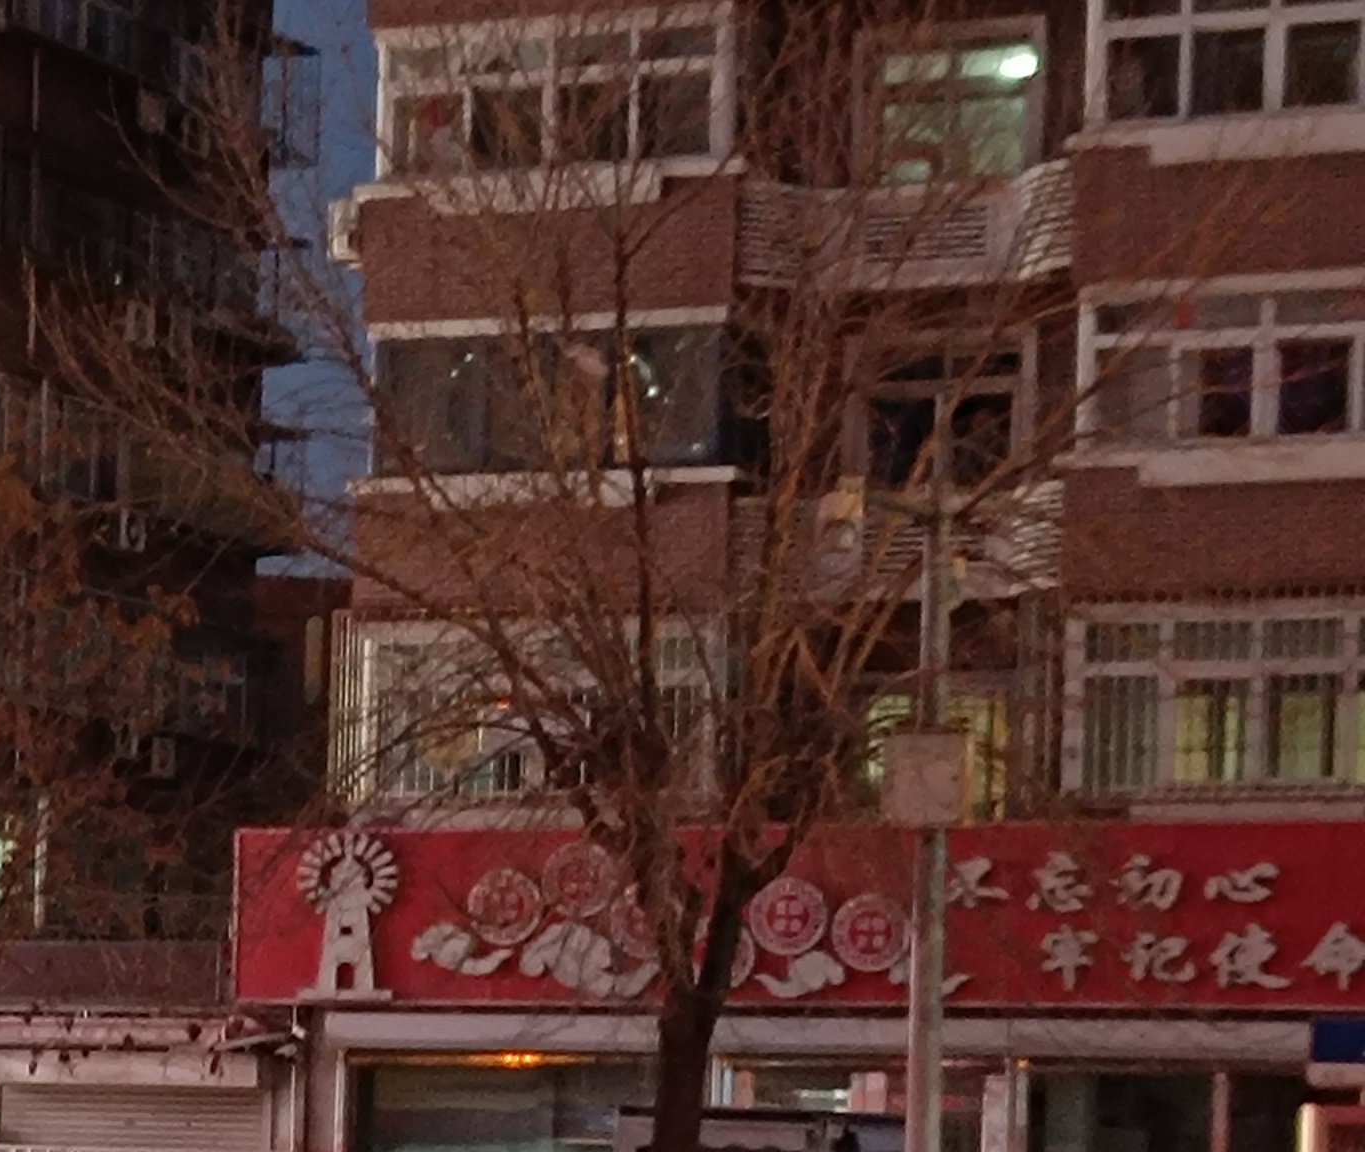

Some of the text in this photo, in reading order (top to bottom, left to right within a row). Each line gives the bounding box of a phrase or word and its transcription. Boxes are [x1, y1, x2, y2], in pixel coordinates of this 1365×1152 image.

[946, 851, 1281, 912] 不忘初心
[1040, 921, 1365, 992] 牢记使命
